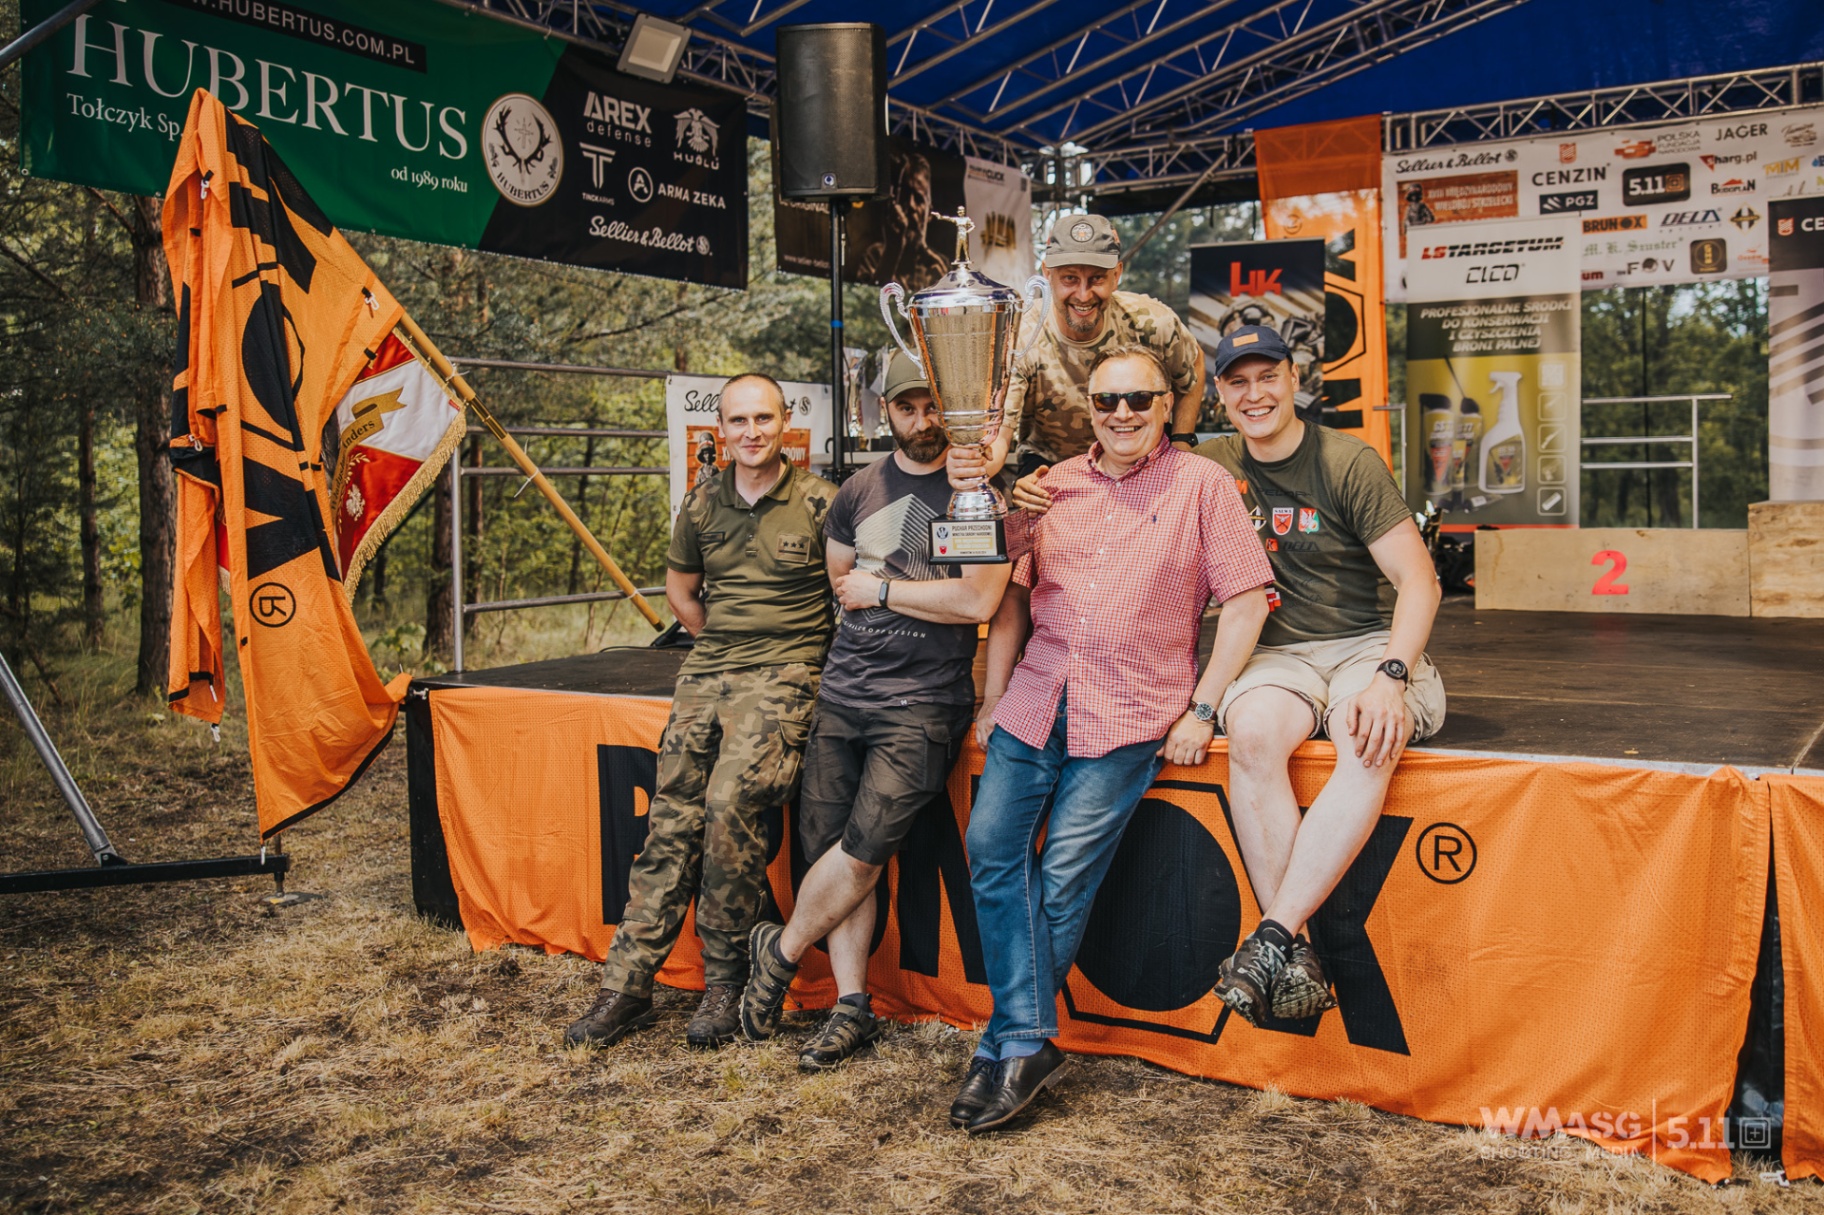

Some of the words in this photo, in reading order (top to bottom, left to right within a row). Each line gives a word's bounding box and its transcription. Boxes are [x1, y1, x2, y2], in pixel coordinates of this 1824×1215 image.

[66, 13, 469, 160] HUBERTUS
[66, 93, 153, 133] Tołczyk
[583, 90, 652, 134] AREX
[586, 120, 652, 148] defense
[390, 165, 409, 182] od
[411, 171, 439, 192] 1989
[441, 175, 469, 193] roku
[496, 171, 550, 200] HUBERTUS
[1531, 166, 1607, 187] CENZIN
[1629, 176, 1666, 196] 5.11
[658, 182, 690, 202] ARMA
[693, 190, 727, 210] ZEKA
[1565, 195, 1595, 208] PGZ
[1583, 216, 1643, 233] BRUNOX
[649, 227, 695, 253] Bellot
[1420, 303, 1520, 319] PROFESJONALNE
[1442, 319, 1460, 329] DO
[1496, 337, 1542, 349] PALNEJ
[1591, 550, 1629, 595] 2
